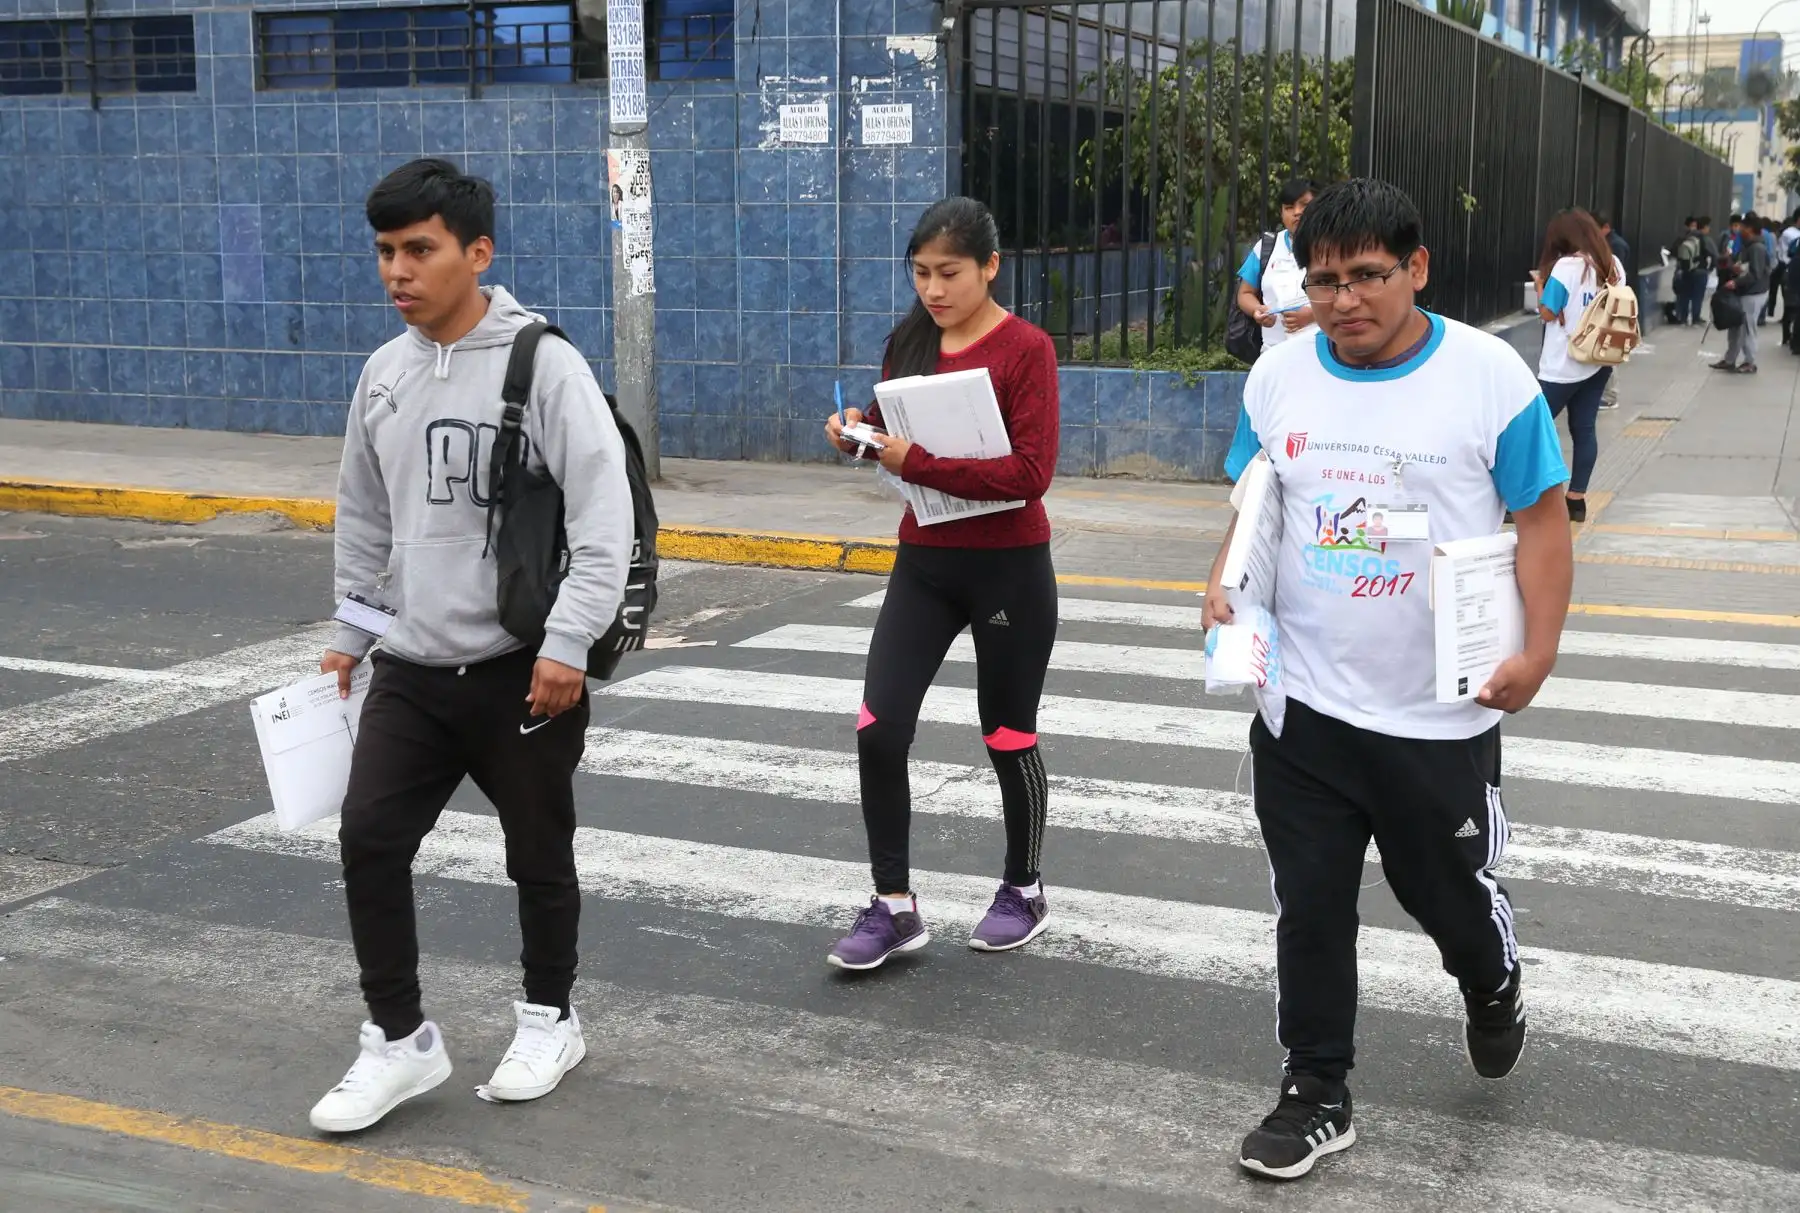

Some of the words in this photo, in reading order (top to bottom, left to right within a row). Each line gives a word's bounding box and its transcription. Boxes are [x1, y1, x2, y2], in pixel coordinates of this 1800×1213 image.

[612, 59, 643, 77] ATRASO
[1307, 441, 1370, 454] UNIVERSIDAD
[1404, 452, 1448, 465] VALLEJO
[1321, 469, 1333, 479] SE
[1336, 470, 1356, 481] UNE
[1358, 472, 1365, 482] A
[1368, 473, 1386, 485] LOS
[1302, 544, 1401, 582] CENSOS
[1351, 572, 1416, 599] 2017
[272, 709, 291, 724] INEI
[522, 1008, 550, 1018] Reebok
